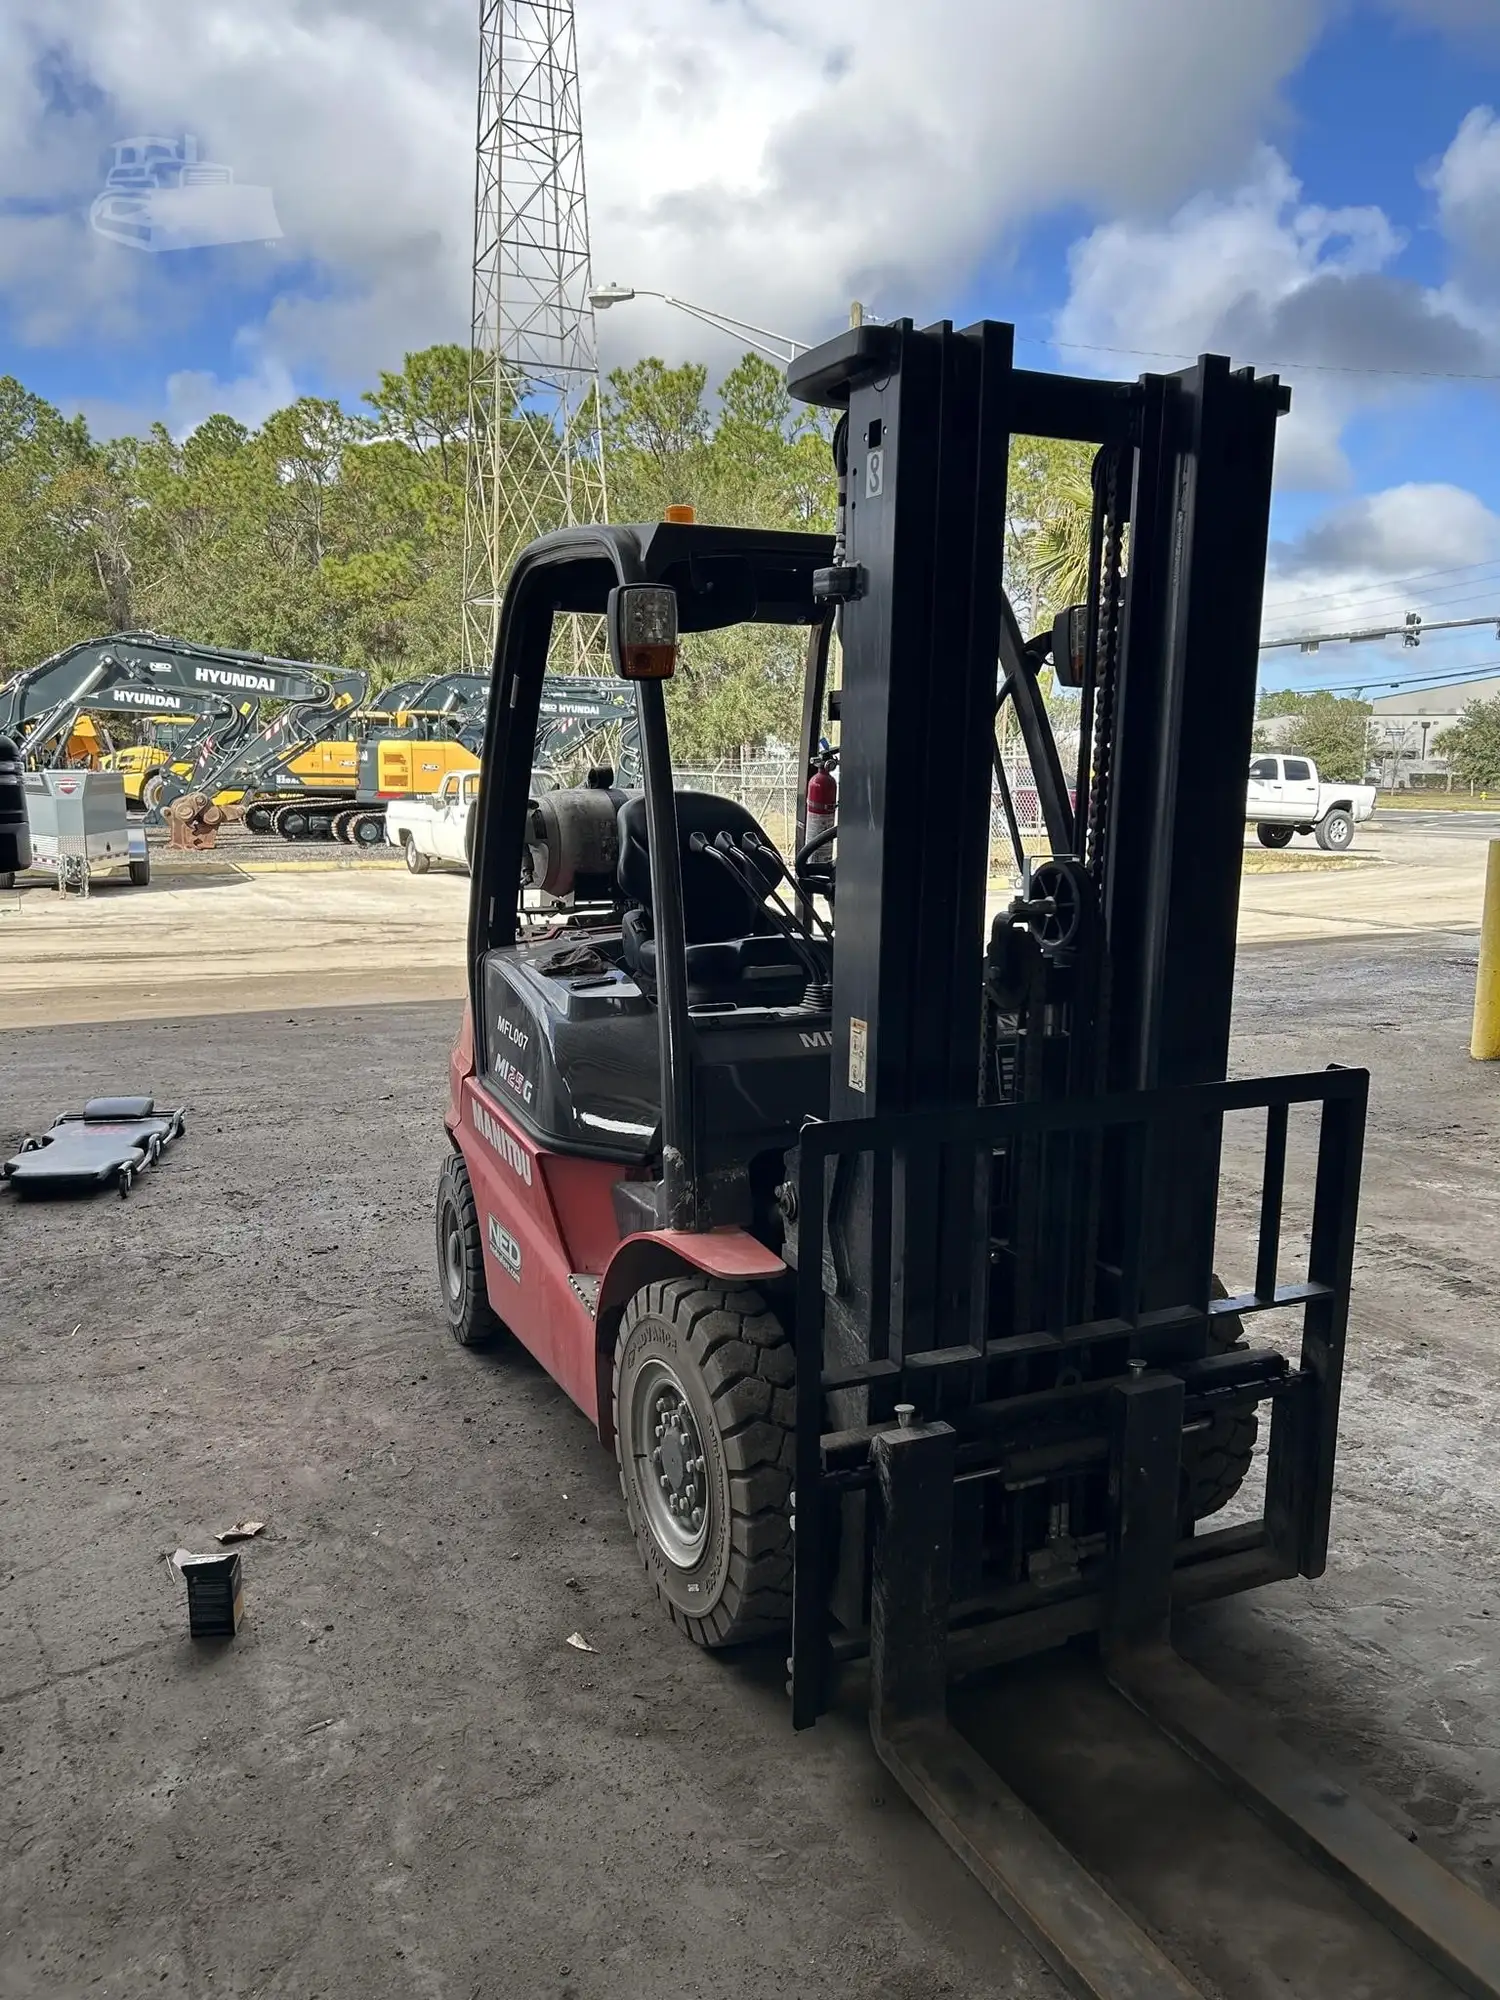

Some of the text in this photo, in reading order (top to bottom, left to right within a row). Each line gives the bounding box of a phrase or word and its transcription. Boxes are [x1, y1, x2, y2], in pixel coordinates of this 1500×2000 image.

[195, 667, 275, 692] HYUNDAI
[113, 689, 181, 709] HYUNDAI
[558, 704, 600, 715] HYUNDAI
[497, 1015, 529, 1050] MFL007
[494, 1053, 533, 1104] MI25G
[471, 1097, 532, 1186] MANITOU
[488, 1214, 521, 1269] NED
